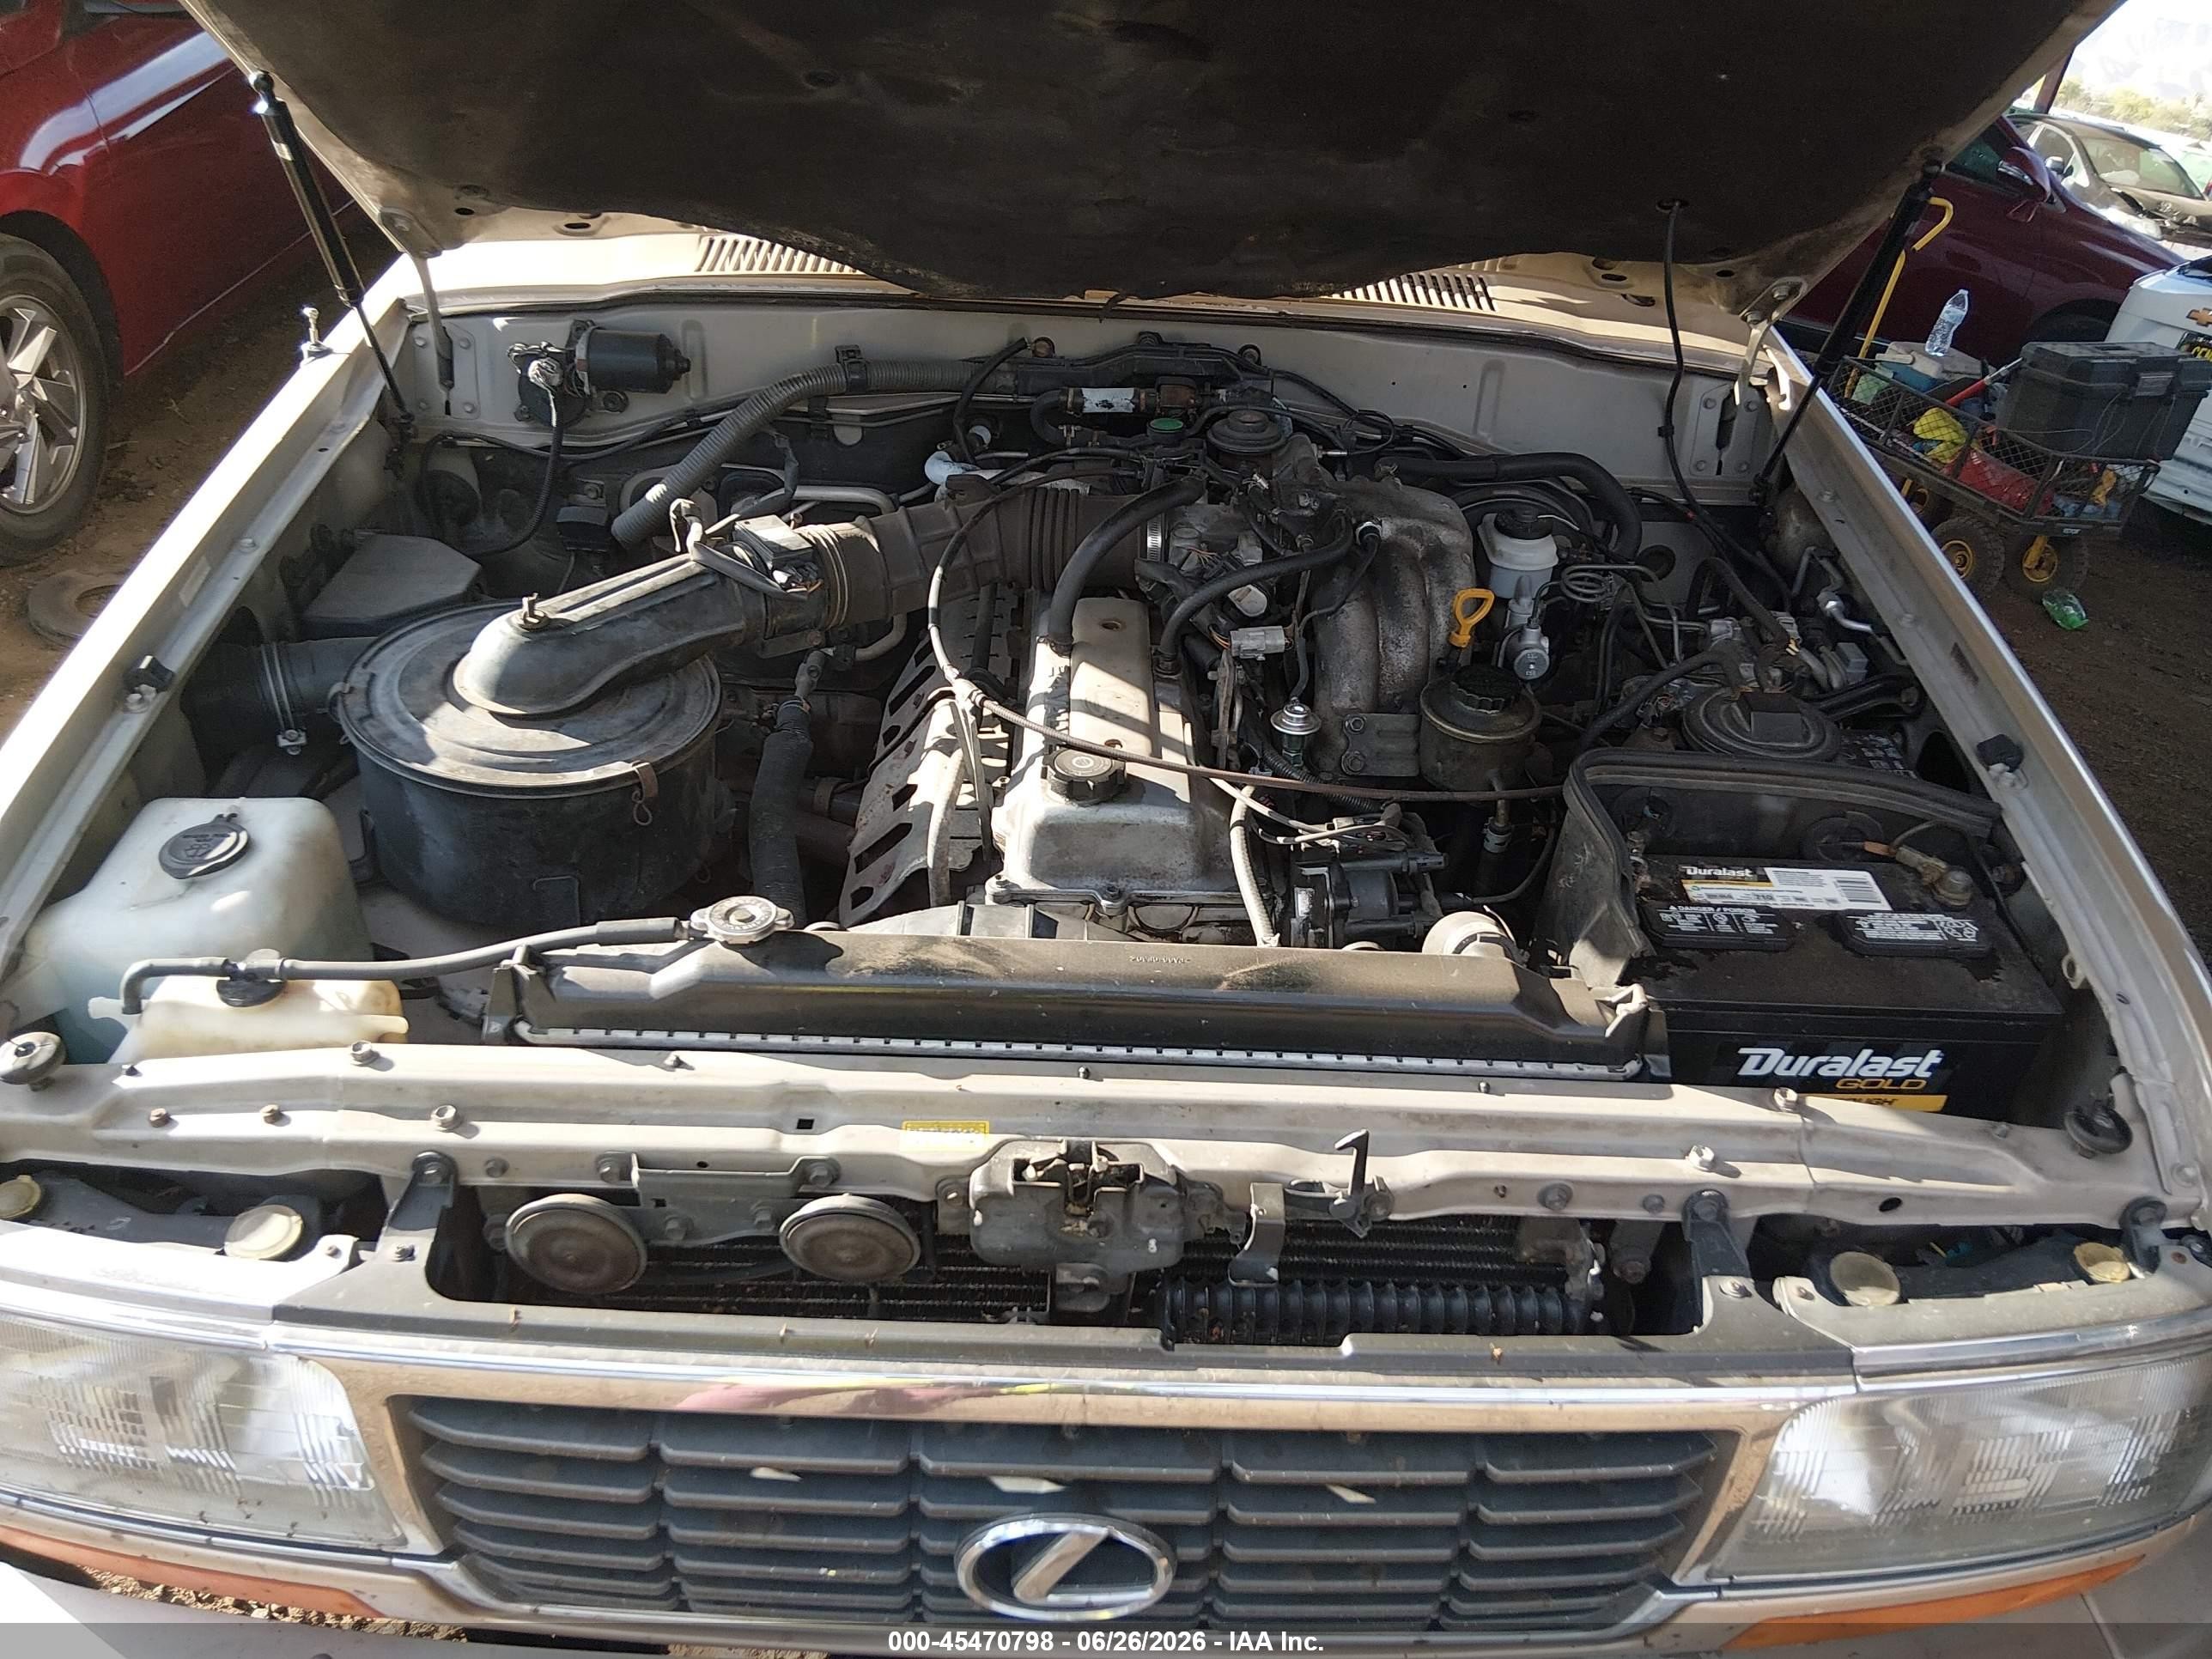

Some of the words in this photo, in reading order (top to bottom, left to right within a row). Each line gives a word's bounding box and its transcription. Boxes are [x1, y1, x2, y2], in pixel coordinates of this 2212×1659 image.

[1680, 866, 1754, 876] Duralast
[1737, 1048, 1943, 1078] Duralast
[1835, 1078, 1927, 1090] GOLD
